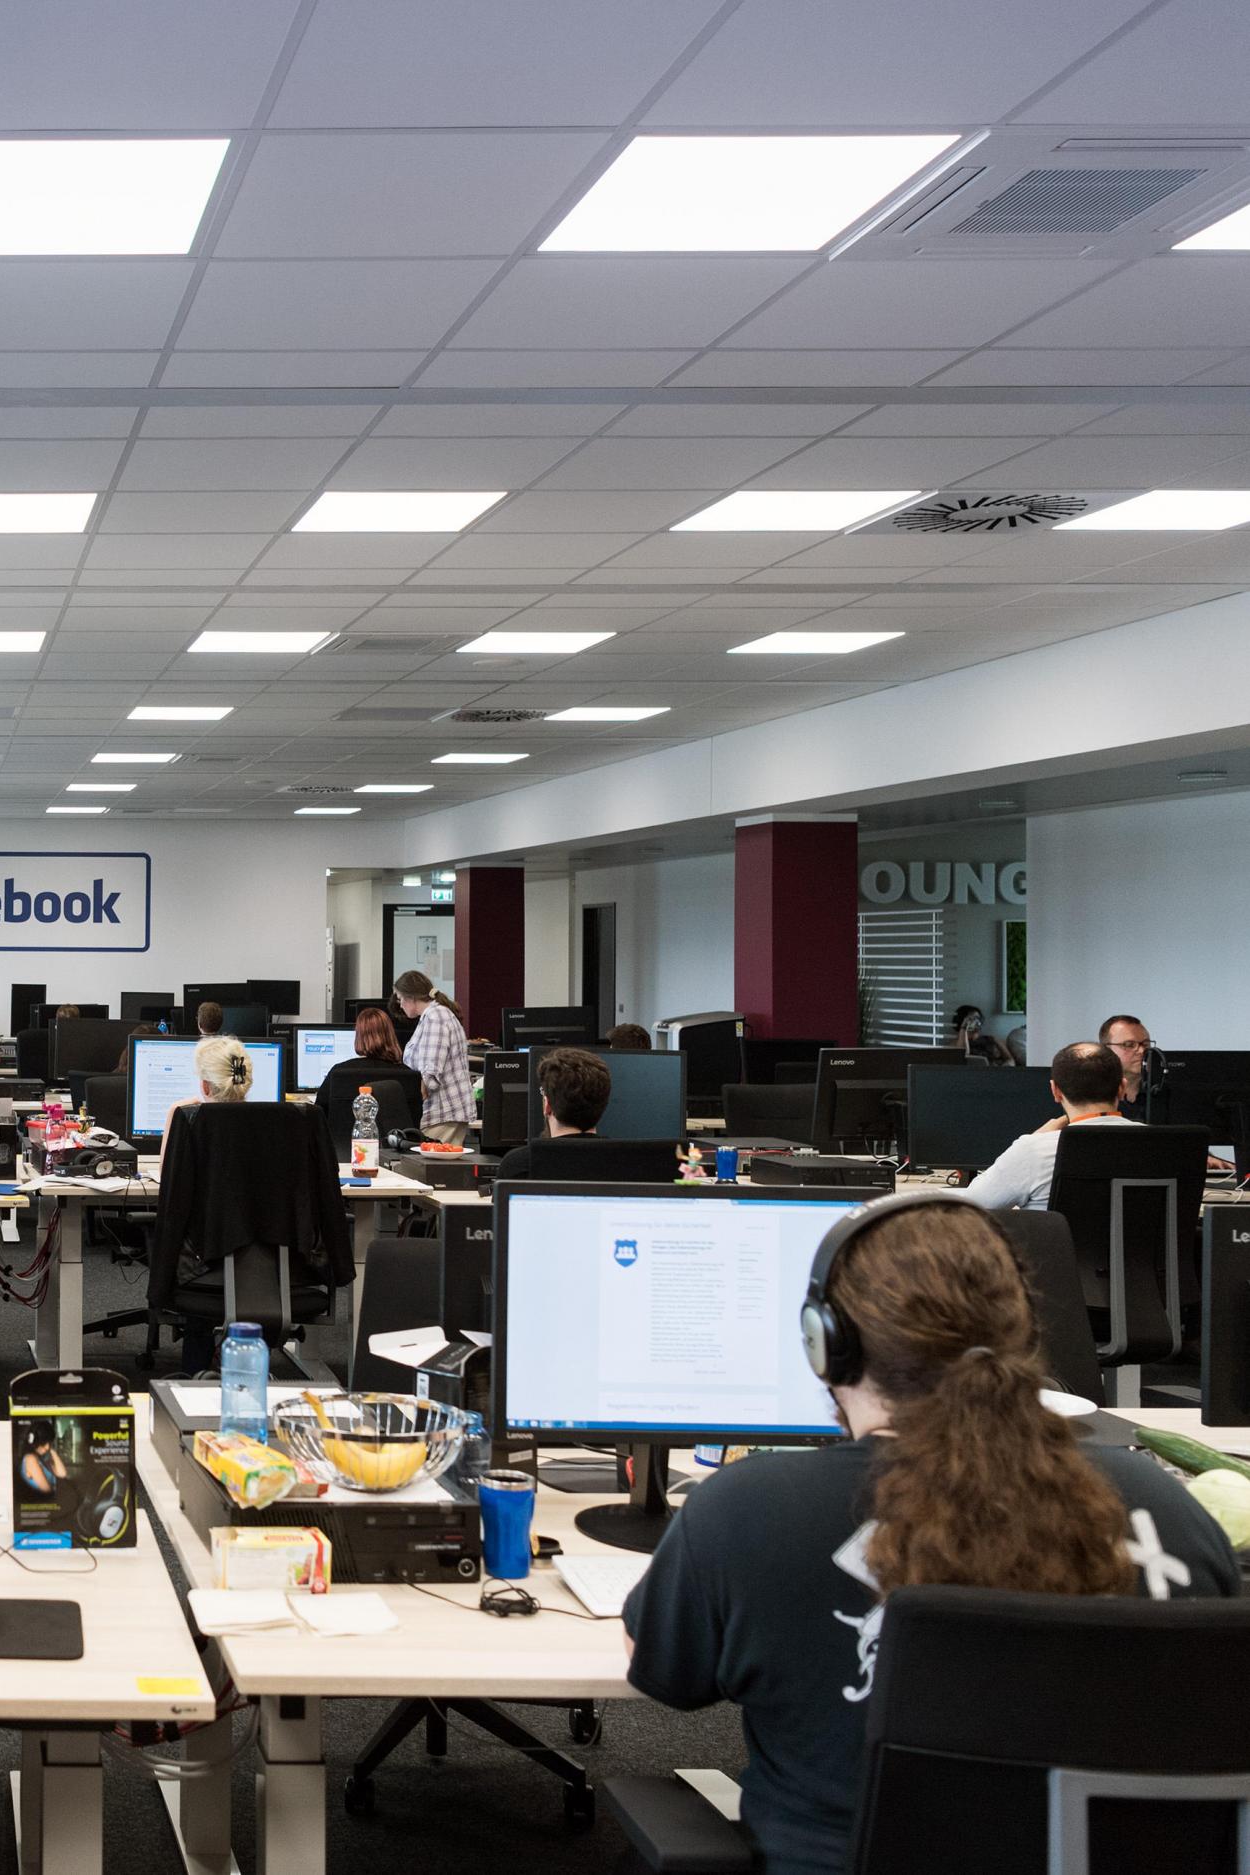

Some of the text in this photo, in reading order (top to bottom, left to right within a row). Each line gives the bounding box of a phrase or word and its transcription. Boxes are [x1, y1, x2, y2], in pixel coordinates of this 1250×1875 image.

[466, 1226, 494, 1240] Len
[93, 1431, 129, 1441] Powerful
[506, 1431, 534, 1440] Lenovo
[90, 1446, 129, 1455] Experience
